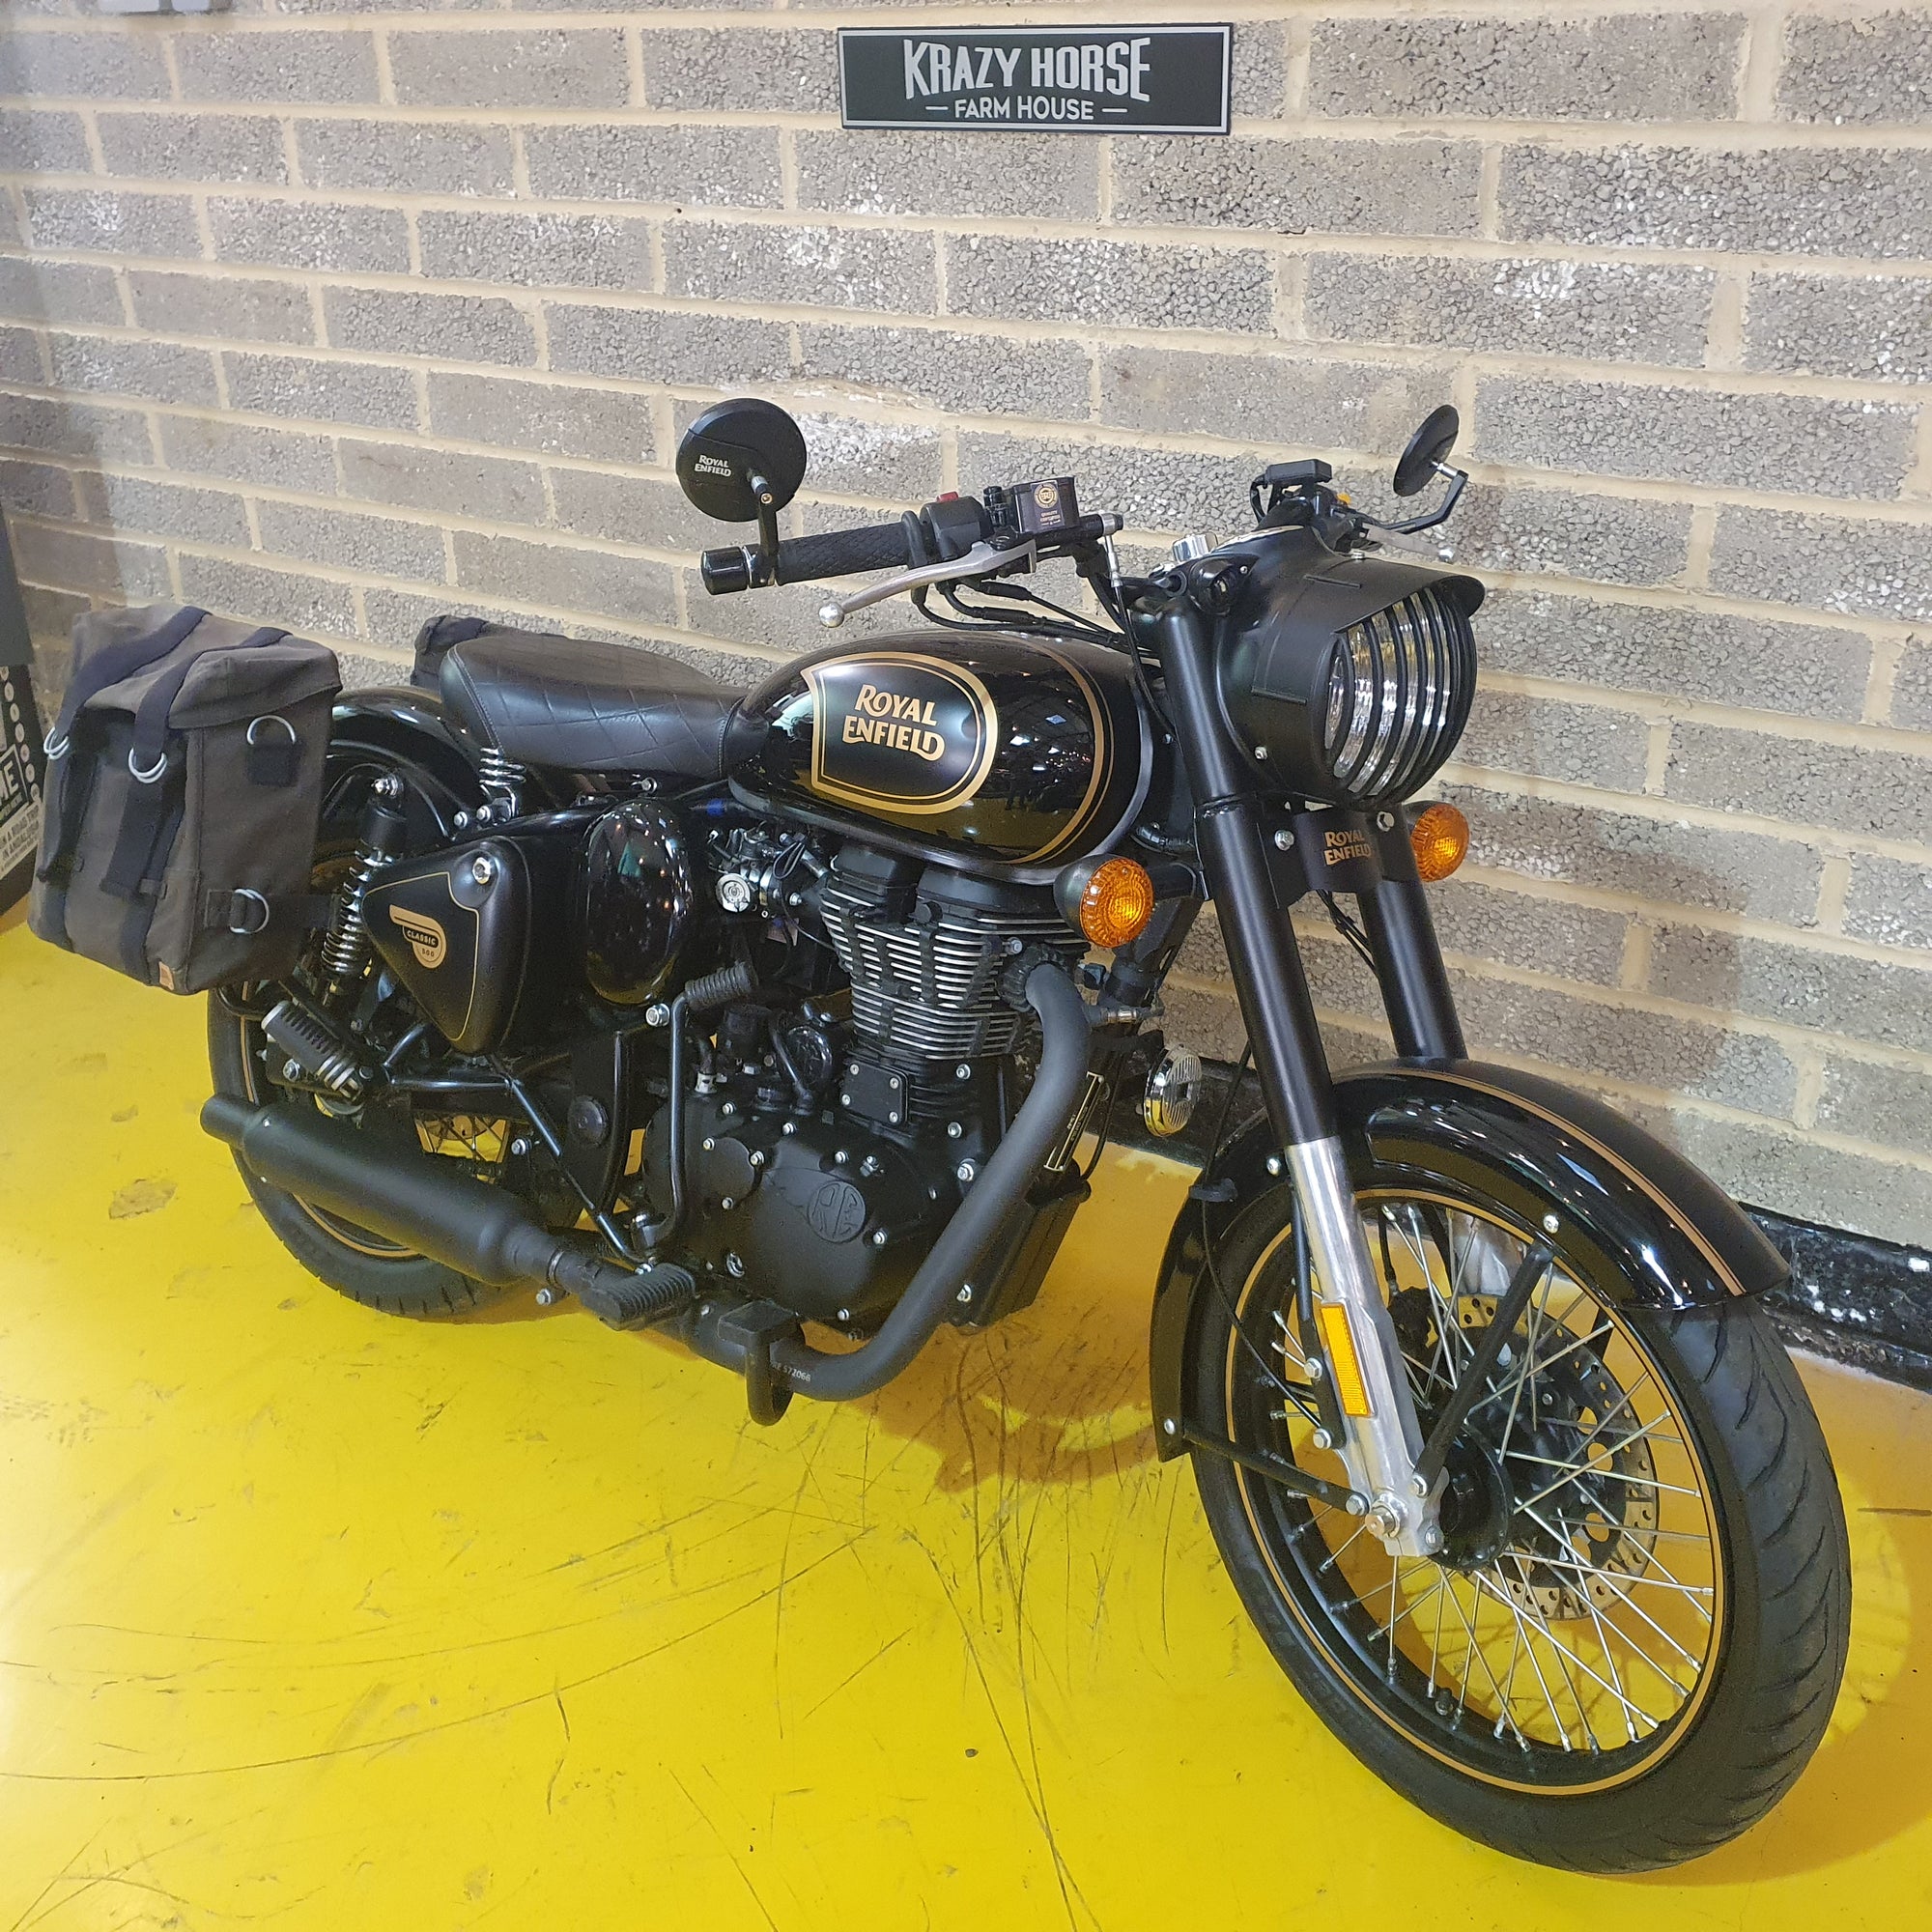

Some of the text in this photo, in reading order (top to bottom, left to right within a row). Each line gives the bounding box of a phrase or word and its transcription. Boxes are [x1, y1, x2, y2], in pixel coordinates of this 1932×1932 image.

[903, 37, 1151, 102] KRAZY HORSE
[954, 96, 1094, 120] FARM HOUSE
[694, 463, 732, 477] ENFIELD
[698, 454, 729, 469] ROYAL
[854, 684, 938, 726] ROYAL
[842, 715, 946, 762] ENFIELD
[1324, 829, 1365, 847] ROYAL
[1324, 843, 1372, 866] ENFIELD
[407, 929, 437, 945] CLASSIC
